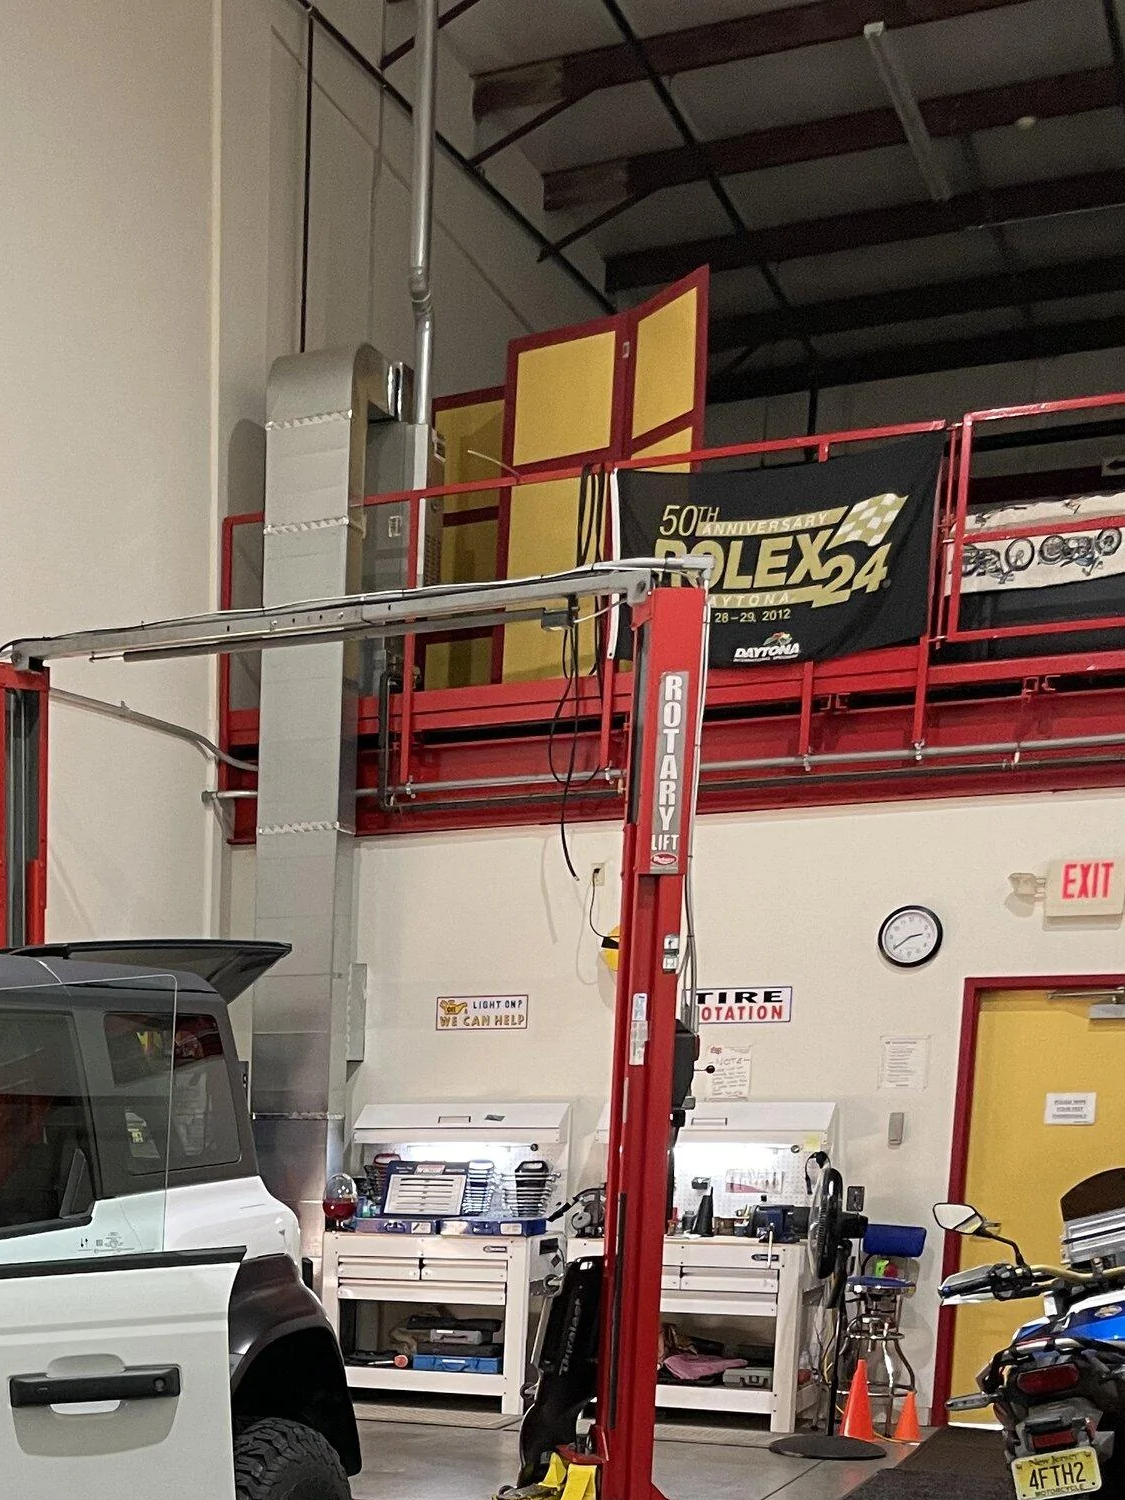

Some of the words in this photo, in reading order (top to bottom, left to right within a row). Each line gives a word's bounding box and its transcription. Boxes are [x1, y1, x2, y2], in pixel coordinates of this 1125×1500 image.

[659, 505, 720, 536] 50TH
[702, 512, 828, 536] ANNIVERSARY
[818, 543, 892, 600] 24
[710, 592, 791, 607] AYTONA
[762, 608, 791, 621] 2012
[734, 642, 800, 658] DAYTONA
[658, 675, 683, 831] ROTARY
[651, 834, 679, 851] LIFT
[1061, 861, 1115, 899] EXIT
[473, 1000, 501, 1009] LIGHT
[504, 999, 523, 1008] ON?
[696, 990, 784, 1005] TIRE
[439, 1015, 458, 1027] WE
[463, 1015, 490, 1027] CAN
[494, 1014, 525, 1026] HELP
[701, 1005, 783, 1021] OTATION
[1029, 1462, 1086, 1490] 4FTH2
[1035, 1484, 1084, 1498] MOTORCYCLE
